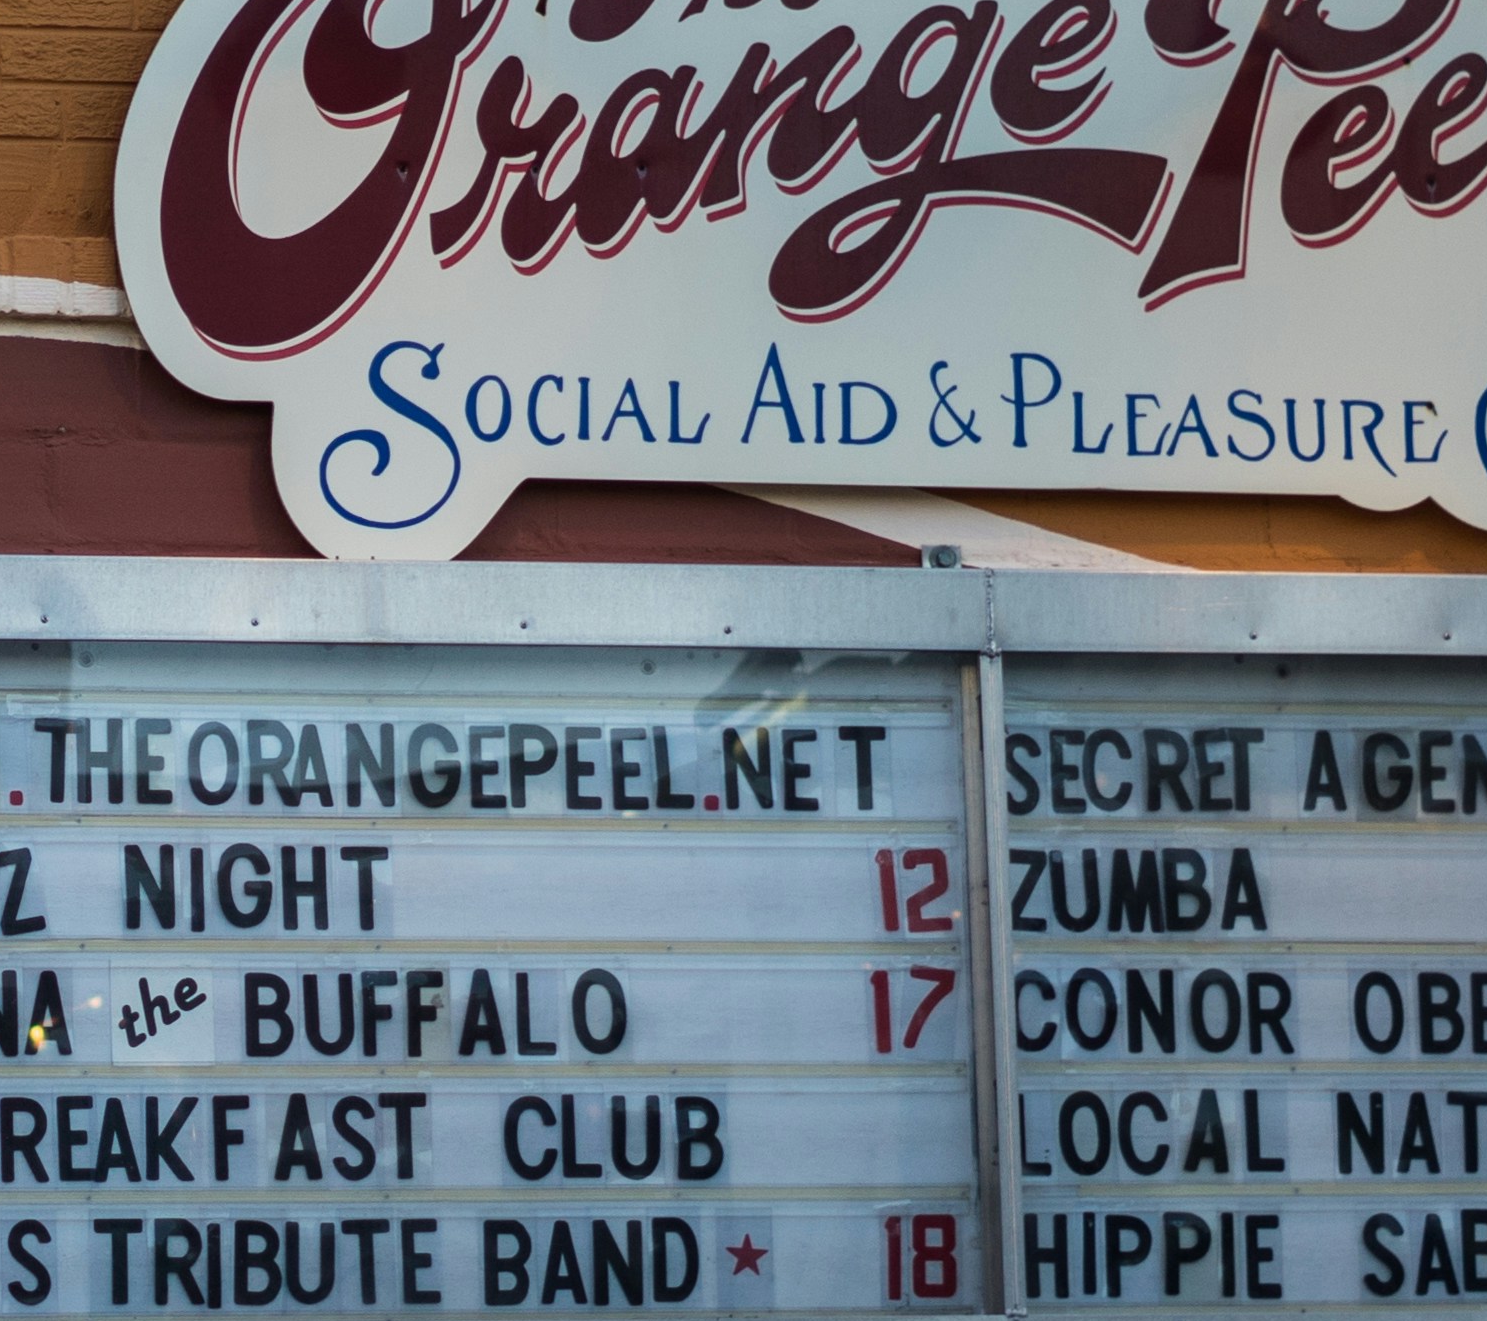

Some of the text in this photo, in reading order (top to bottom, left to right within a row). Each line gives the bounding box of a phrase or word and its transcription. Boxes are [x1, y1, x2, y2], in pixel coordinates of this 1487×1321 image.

[929, 361, 981, 447] &
[1006, 728, 1263, 815] SECRET
[125, 844, 387, 931] NIGHT
[878, 850, 951, 931] 12
[1010, 849, 1266, 932] ZUMBA
[120, 979, 205, 1047] the
[246, 970, 626, 1057] BUFFALO
[872, 968, 953, 1052] 17
[1016, 968, 1294, 1054] CONOR
[505, 1095, 723, 1180] CLUB
[1021, 1090, 1284, 1176] LOCAL
[94, 1219, 441, 1309] TRIBUTE
[484, 1218, 699, 1306] BAND
[888, 1216, 955, 1298] 18
[1027, 1212, 1282, 1299] HIPPIE
